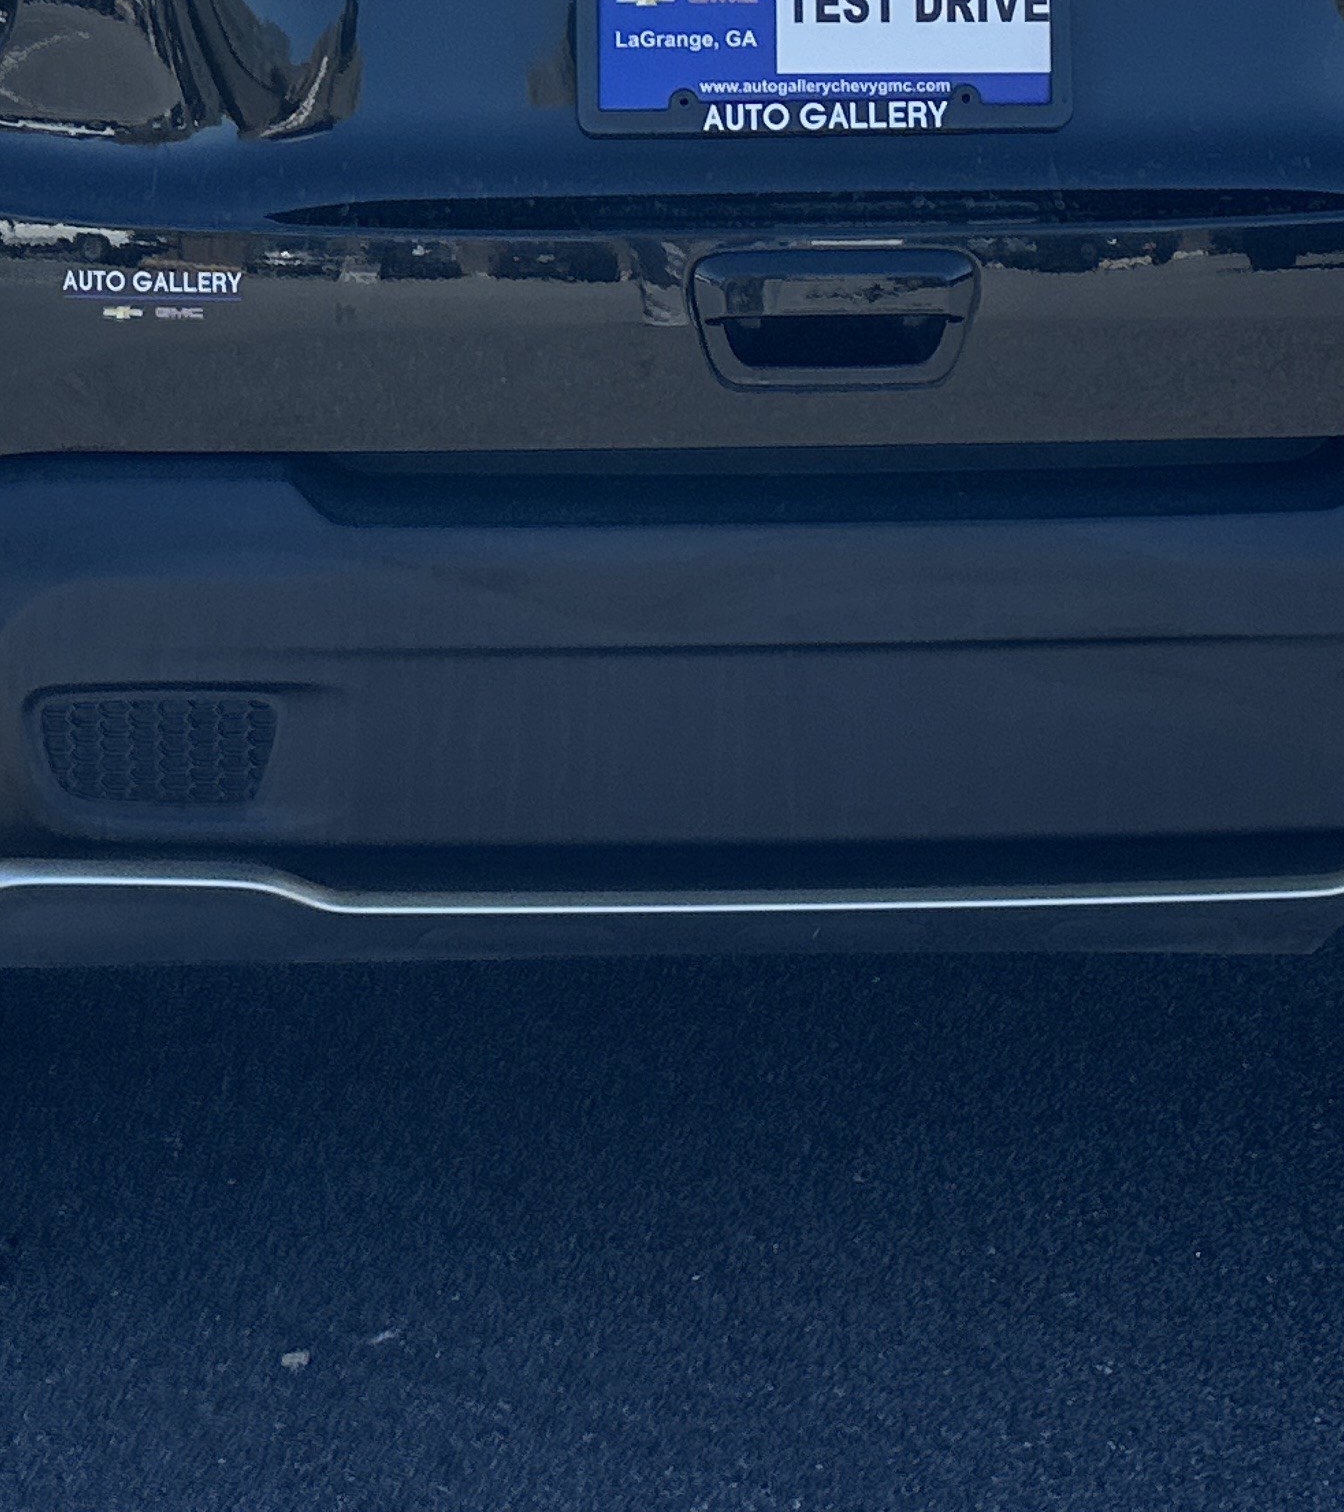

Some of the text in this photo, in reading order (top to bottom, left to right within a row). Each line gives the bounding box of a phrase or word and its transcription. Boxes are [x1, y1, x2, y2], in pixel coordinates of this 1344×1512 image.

[615, 30, 758, 52] LaGrange, GA
[699, 78, 951, 95] www.autogallerychevygmc.com
[703, 100, 949, 132] AUTO GALLERY
[62, 270, 242, 294] AUTO GALLERY
